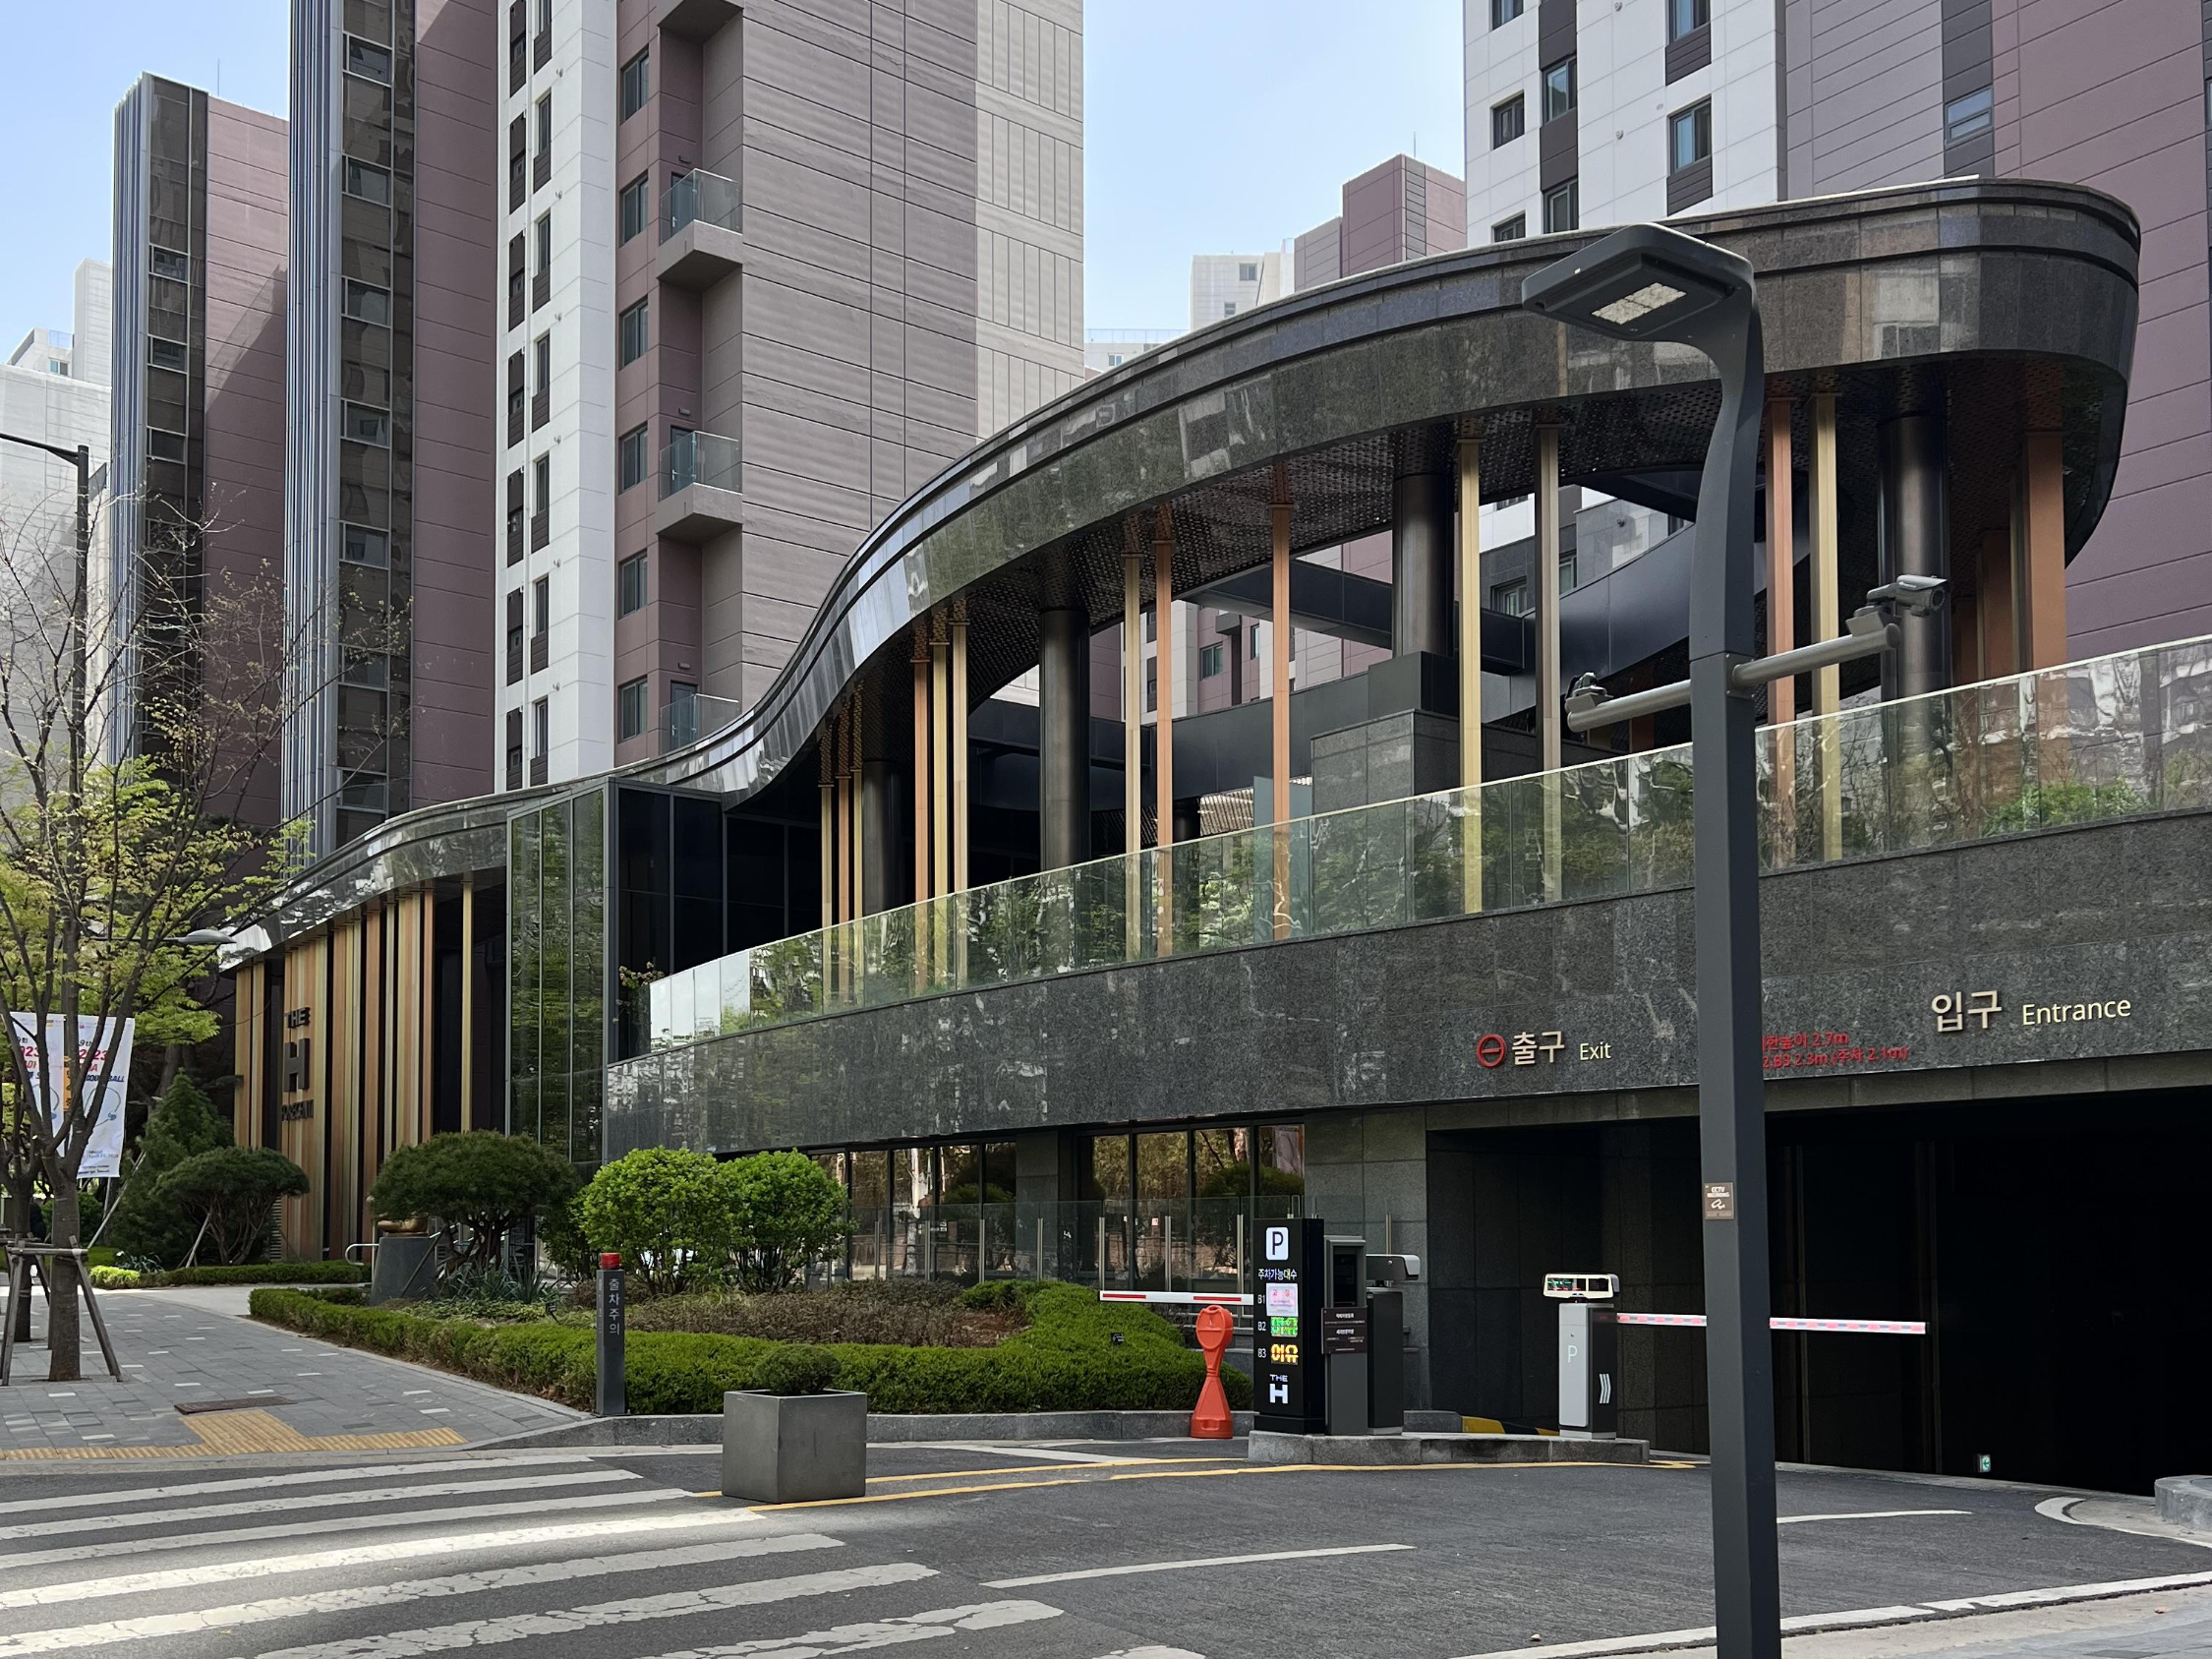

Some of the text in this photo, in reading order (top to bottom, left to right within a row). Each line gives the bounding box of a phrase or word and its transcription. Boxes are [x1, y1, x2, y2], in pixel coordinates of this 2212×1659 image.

[283, 1007, 310, 1028] THE
[1931, 989, 2132, 1033] 입구 Entrance
[1511, 1031, 1612, 1065] 출구 Exit
[1812, 1031, 1850, 1047] 2.7m
[78, 1048, 109, 1061] 223
[1794, 1052, 1828, 1067] 2.3m
[283, 1039, 309, 1092] H
[1272, 1231, 1284, 1255] P
[1257, 1269, 1298, 1280] 주차가능대수
[609, 1278, 620, 1334] 출차주의
[1257, 1294, 1265, 1304] B1
[1257, 1322, 1266, 1332] B2
[1257, 1348, 1266, 1358] B3
[1567, 1345, 1578, 1363] P
[1269, 1383, 1289, 1404] H
